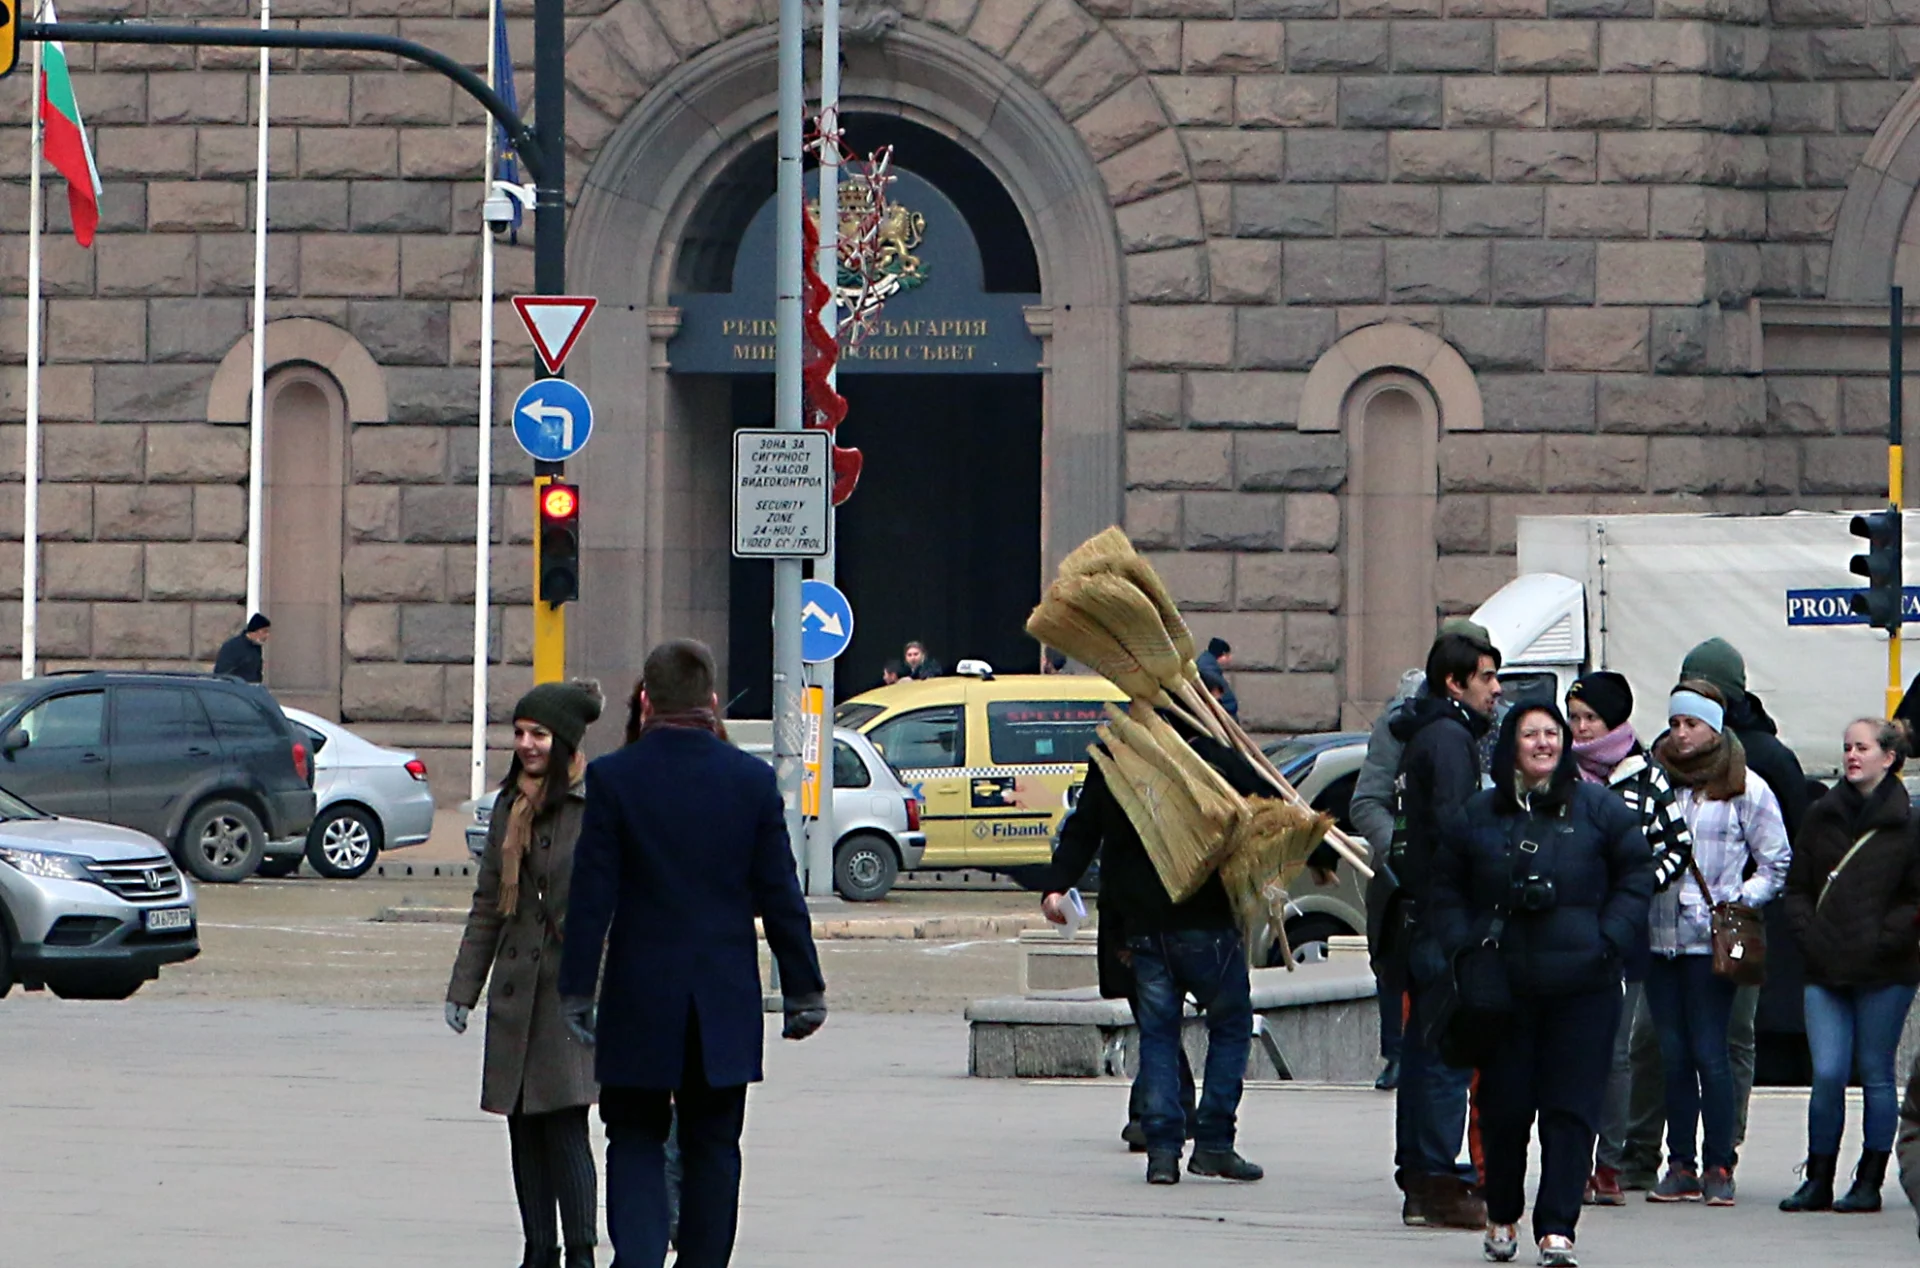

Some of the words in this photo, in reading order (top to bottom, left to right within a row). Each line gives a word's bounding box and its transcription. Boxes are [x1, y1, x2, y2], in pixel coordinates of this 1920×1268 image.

[905, 344, 976, 360] СЪВЕТ
[760, 439, 786, 450] ЗОНА
[793, 439, 805, 450] ЗА
[751, 451, 811, 462] СИГУРНОСТ
[741, 477, 822, 488] ВИДЕОКОНТРОЛ
[755, 500, 806, 511] SECURITY
[766, 512, 794, 523] ZONE
[753, 525, 808, 536] 24-HOUS
[993, 823, 1048, 837] Fibank
